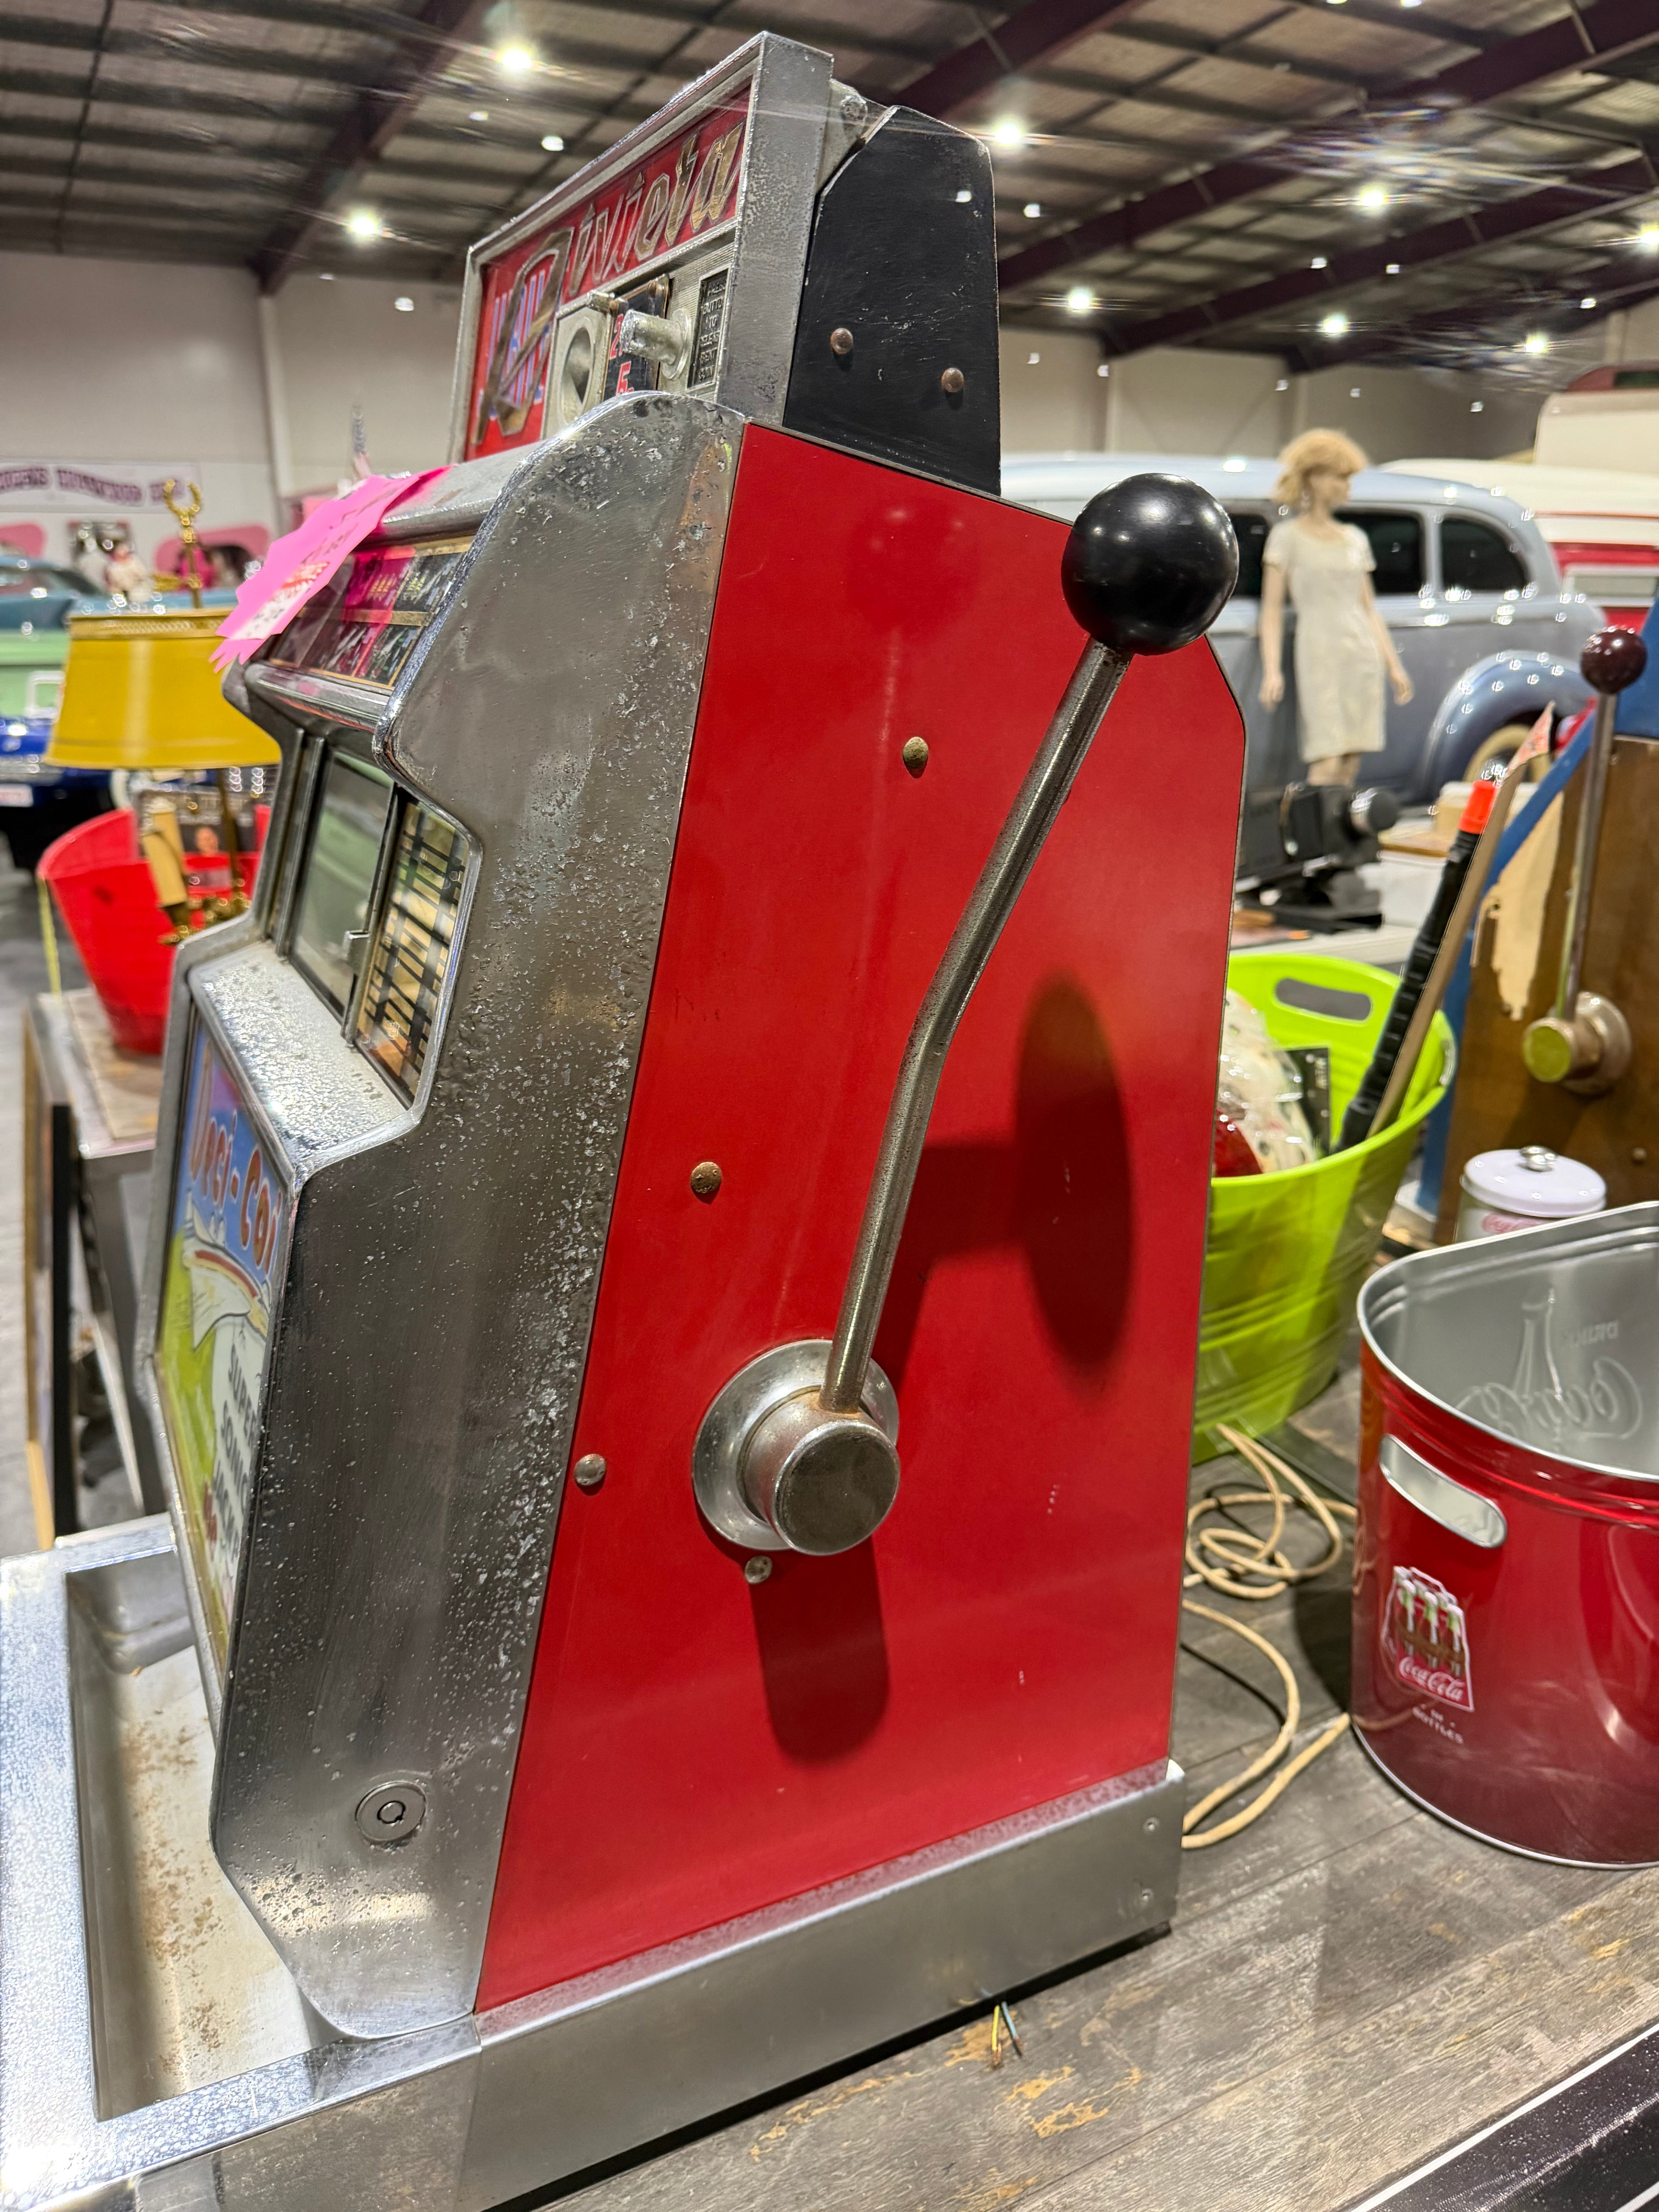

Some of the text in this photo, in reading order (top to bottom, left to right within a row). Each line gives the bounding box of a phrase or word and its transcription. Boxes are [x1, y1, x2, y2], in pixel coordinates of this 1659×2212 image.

[702, 296, 723, 315] BUTTO
[228, 1343, 257, 1448] SUPER
[213, 1459, 240, 1563] JACKP
[1412, 1707, 1464, 1745] BOTTLES
